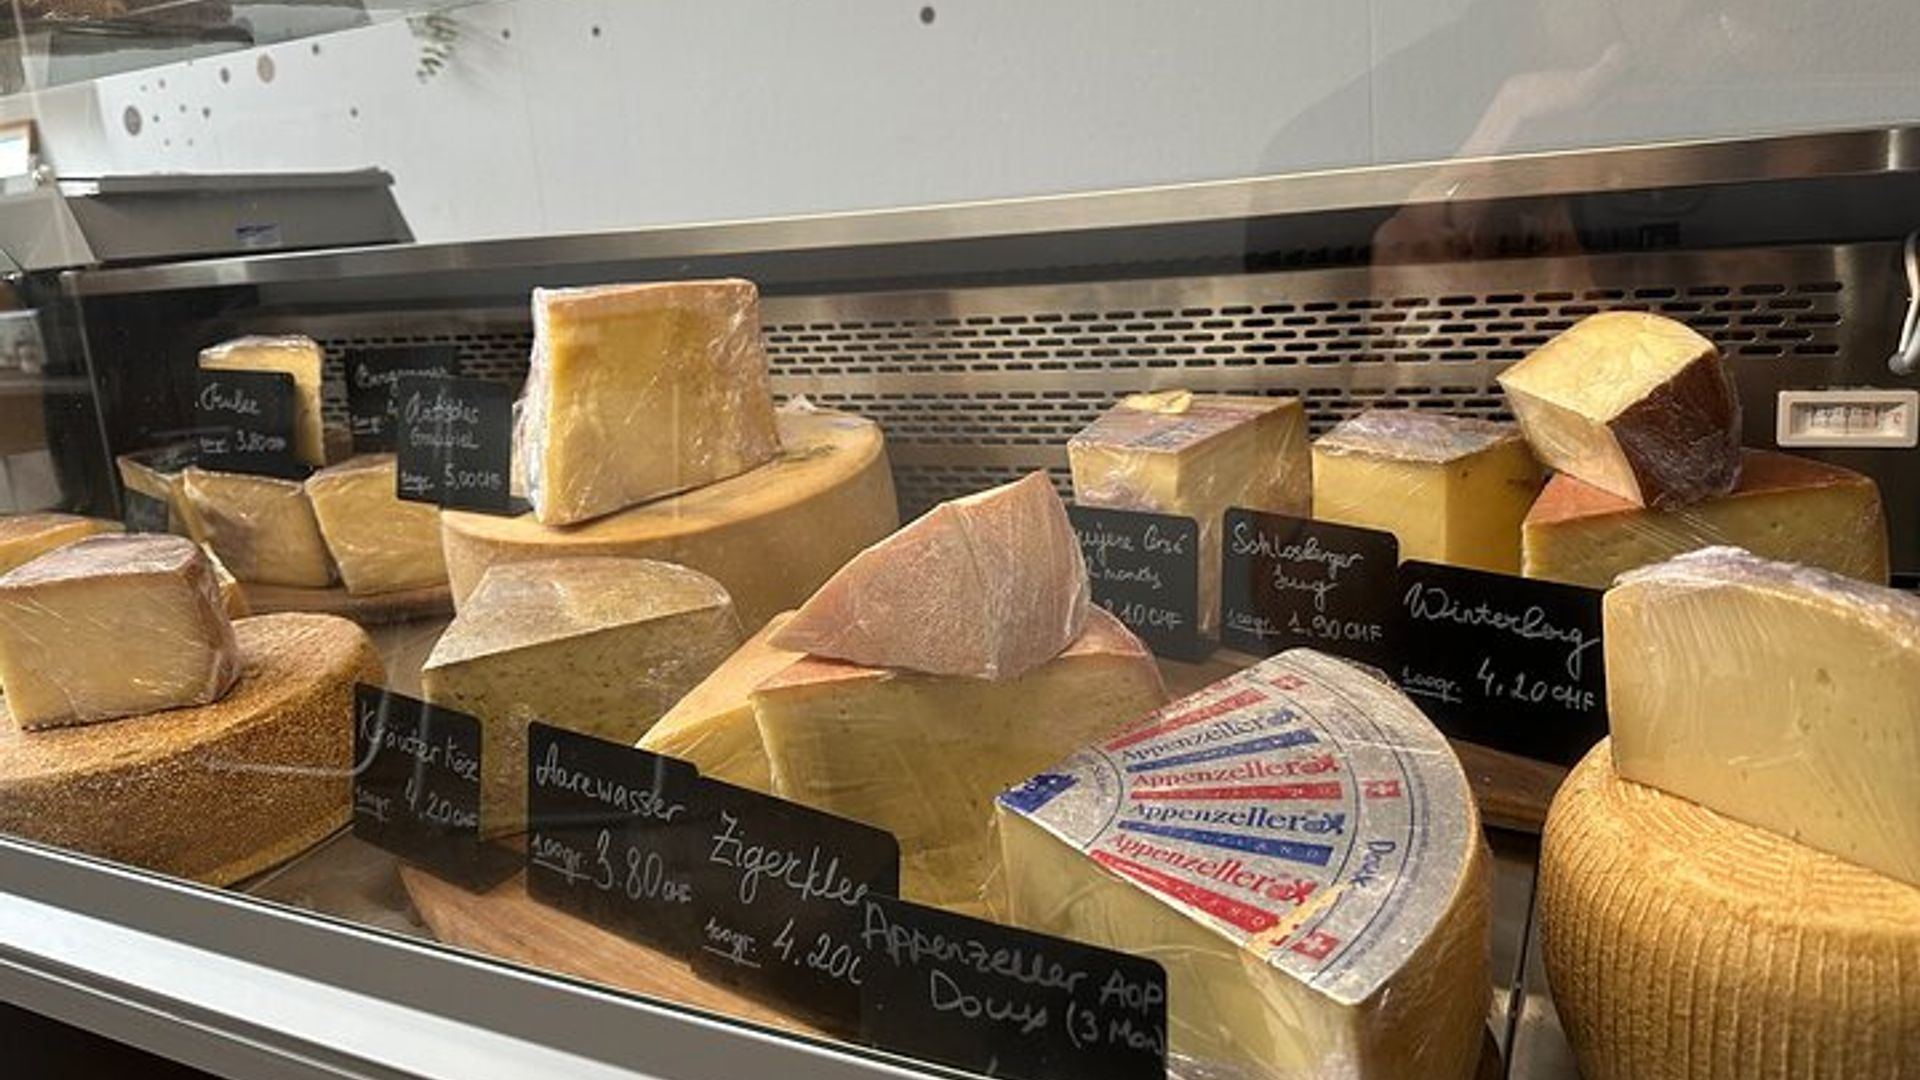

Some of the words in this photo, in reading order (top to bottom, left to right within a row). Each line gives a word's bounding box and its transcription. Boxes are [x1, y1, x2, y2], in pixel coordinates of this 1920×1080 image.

[1121, 715, 1267, 762] Appenzeller
[1131, 760, 1302, 787] Appenzeller
[1130, 803, 1305, 832] Appenzeller
[1108, 833, 1273, 895] Appenzeller
[861, 901, 1088, 994] Appenzeller
[930, 968, 1048, 1033] Doux
